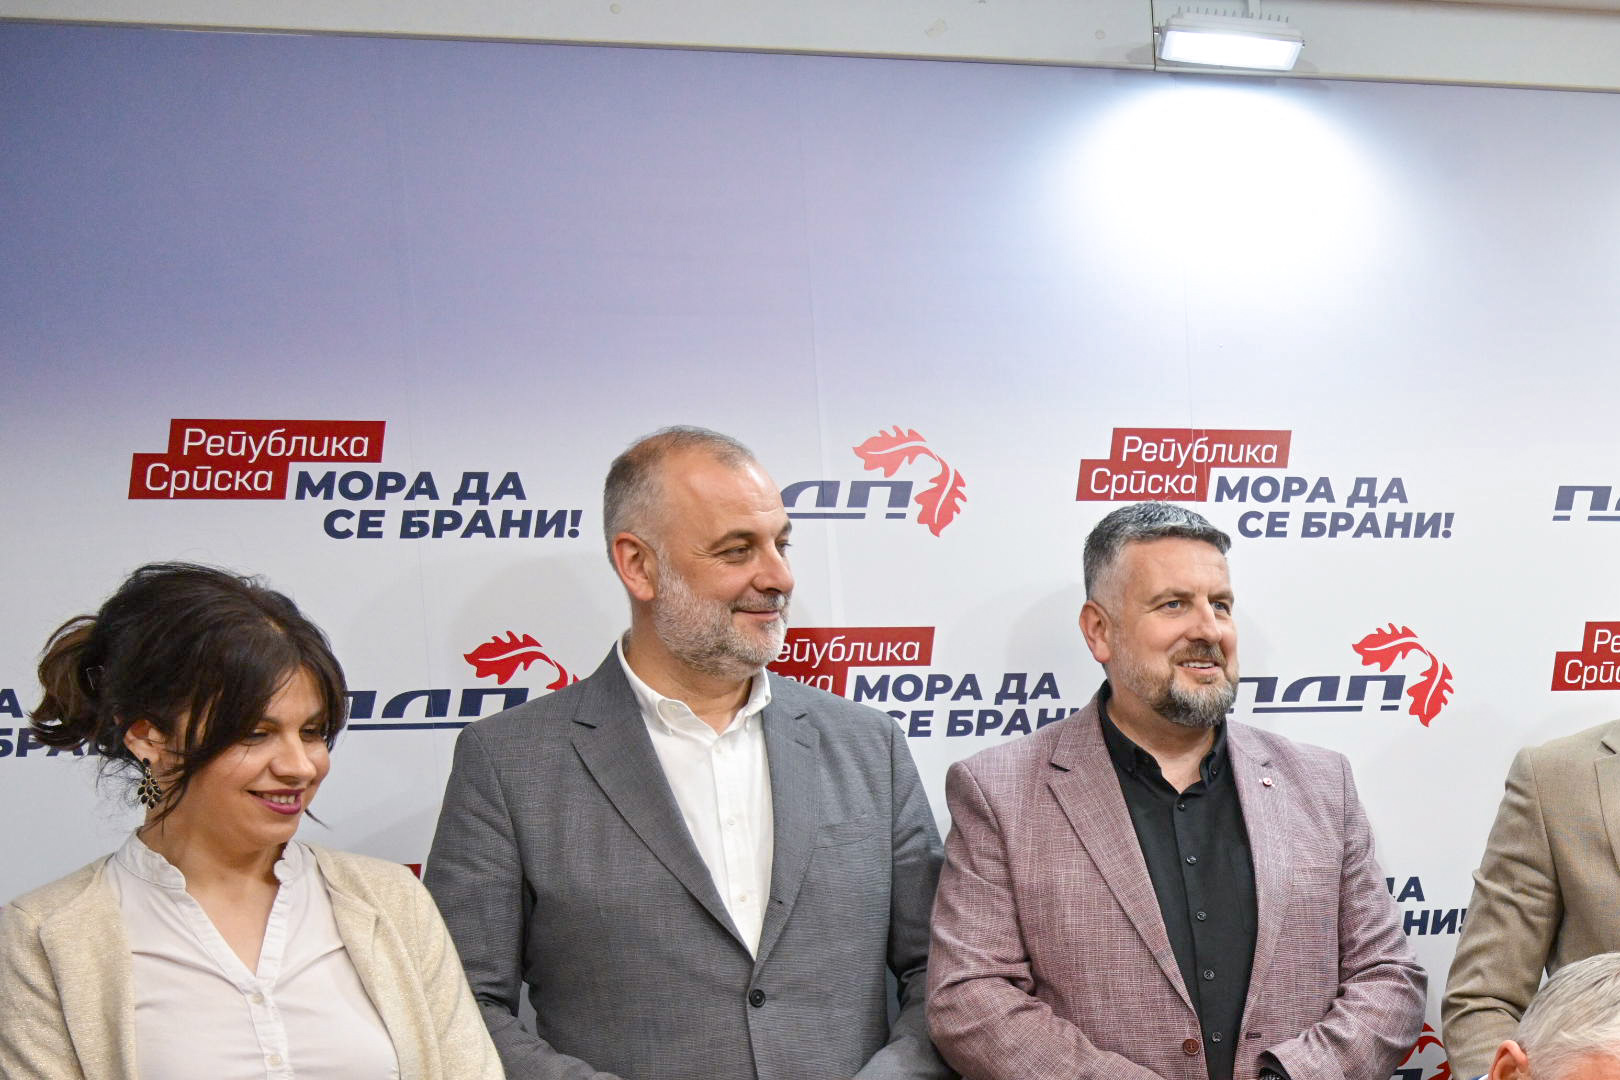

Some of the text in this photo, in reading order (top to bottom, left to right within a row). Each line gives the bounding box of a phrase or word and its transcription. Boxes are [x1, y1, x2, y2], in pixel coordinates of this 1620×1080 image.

[295, 470, 527, 505] МОРА ДА
[1214, 475, 1409, 509] МОРА ДА
[323, 509, 583, 539] СЕ БРАНИ!
[1237, 510, 1455, 539] СЕ БРАНИ!
[779, 635, 921, 668] епублика
[0, 688, 24, 719] А
[852, 673, 983, 703] МОРА
[993, 672, 1061, 706] ДА
[945, 707, 1079, 738] БРАН
[1403, 908, 1467, 936] НИ!
